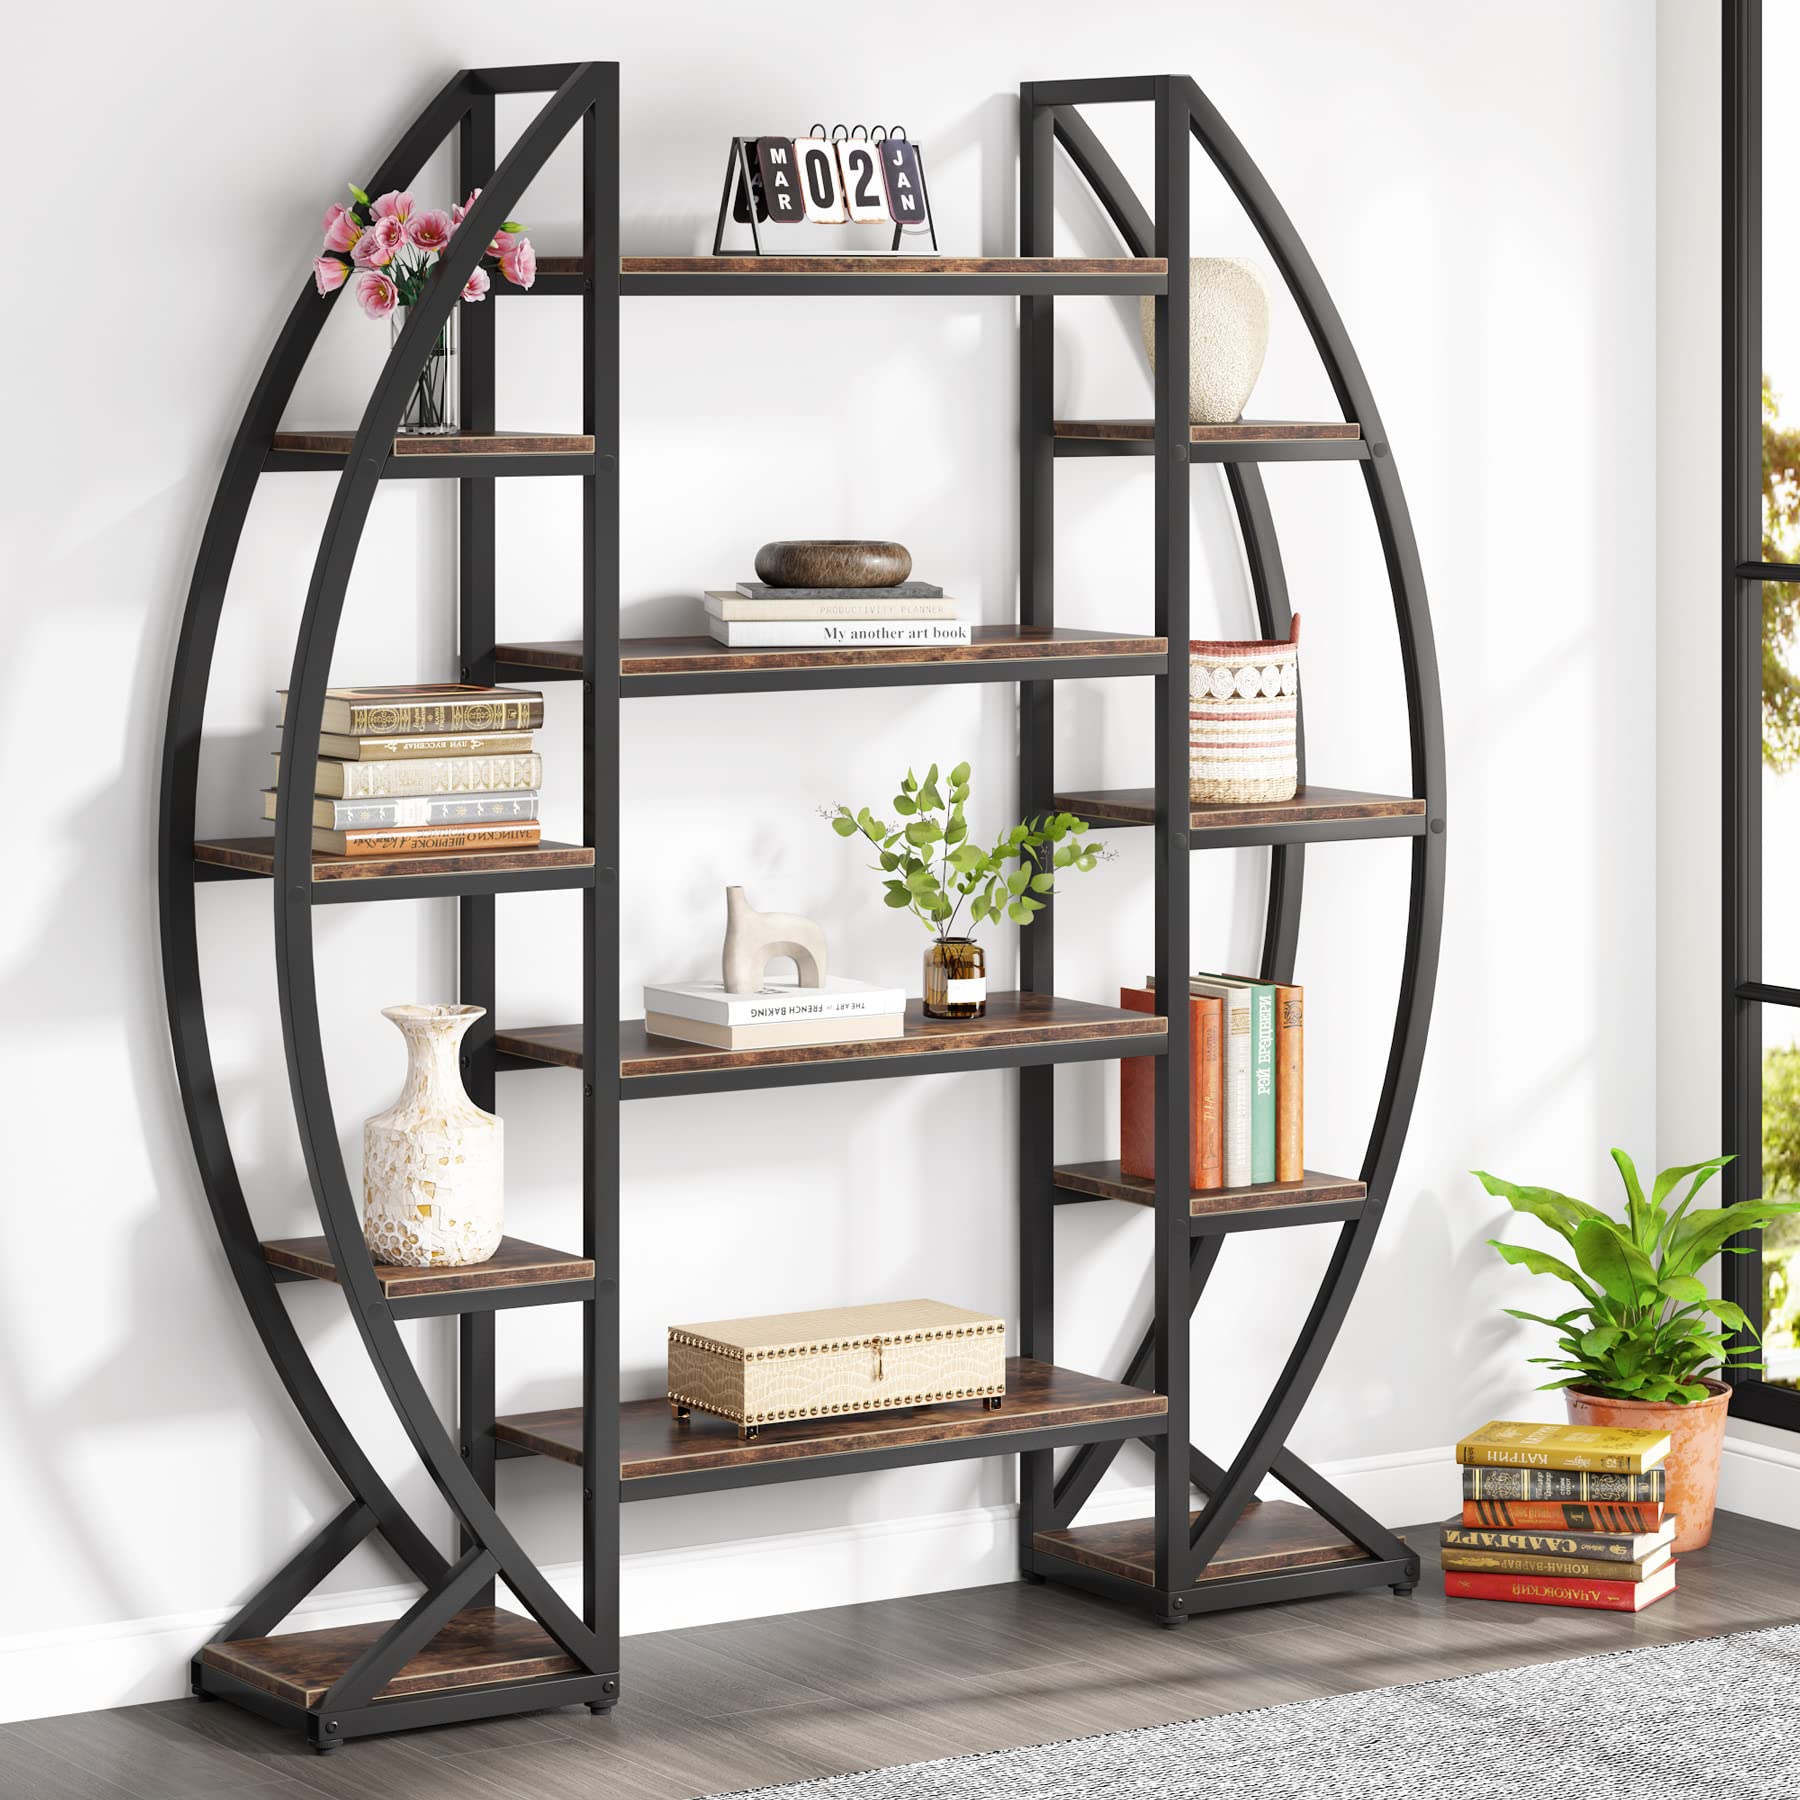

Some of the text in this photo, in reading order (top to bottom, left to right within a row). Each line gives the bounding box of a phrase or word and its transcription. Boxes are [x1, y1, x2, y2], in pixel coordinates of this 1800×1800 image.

[770, 148, 792, 210] MAR
[893, 150, 915, 210] JAN
[820, 606, 944, 616] PRODUCTIVITY PLANNER
[824, 626, 967, 642] My another art book
[411, 838, 465, 848] ШЕРЛОКЕ
[750, 1007, 787, 1018] BAKING
[789, 1004, 823, 1014] FRENCH
[835, 1003, 850, 1011] ART
[1256, 1067, 1271, 1095] РЭЙ
[1487, 1450, 1548, 1465] КАТРИН
[1446, 1530, 1577, 1553] САЛЬГАРИ
[1501, 1560, 1589, 1574] КОНАН-ВАРВАР
